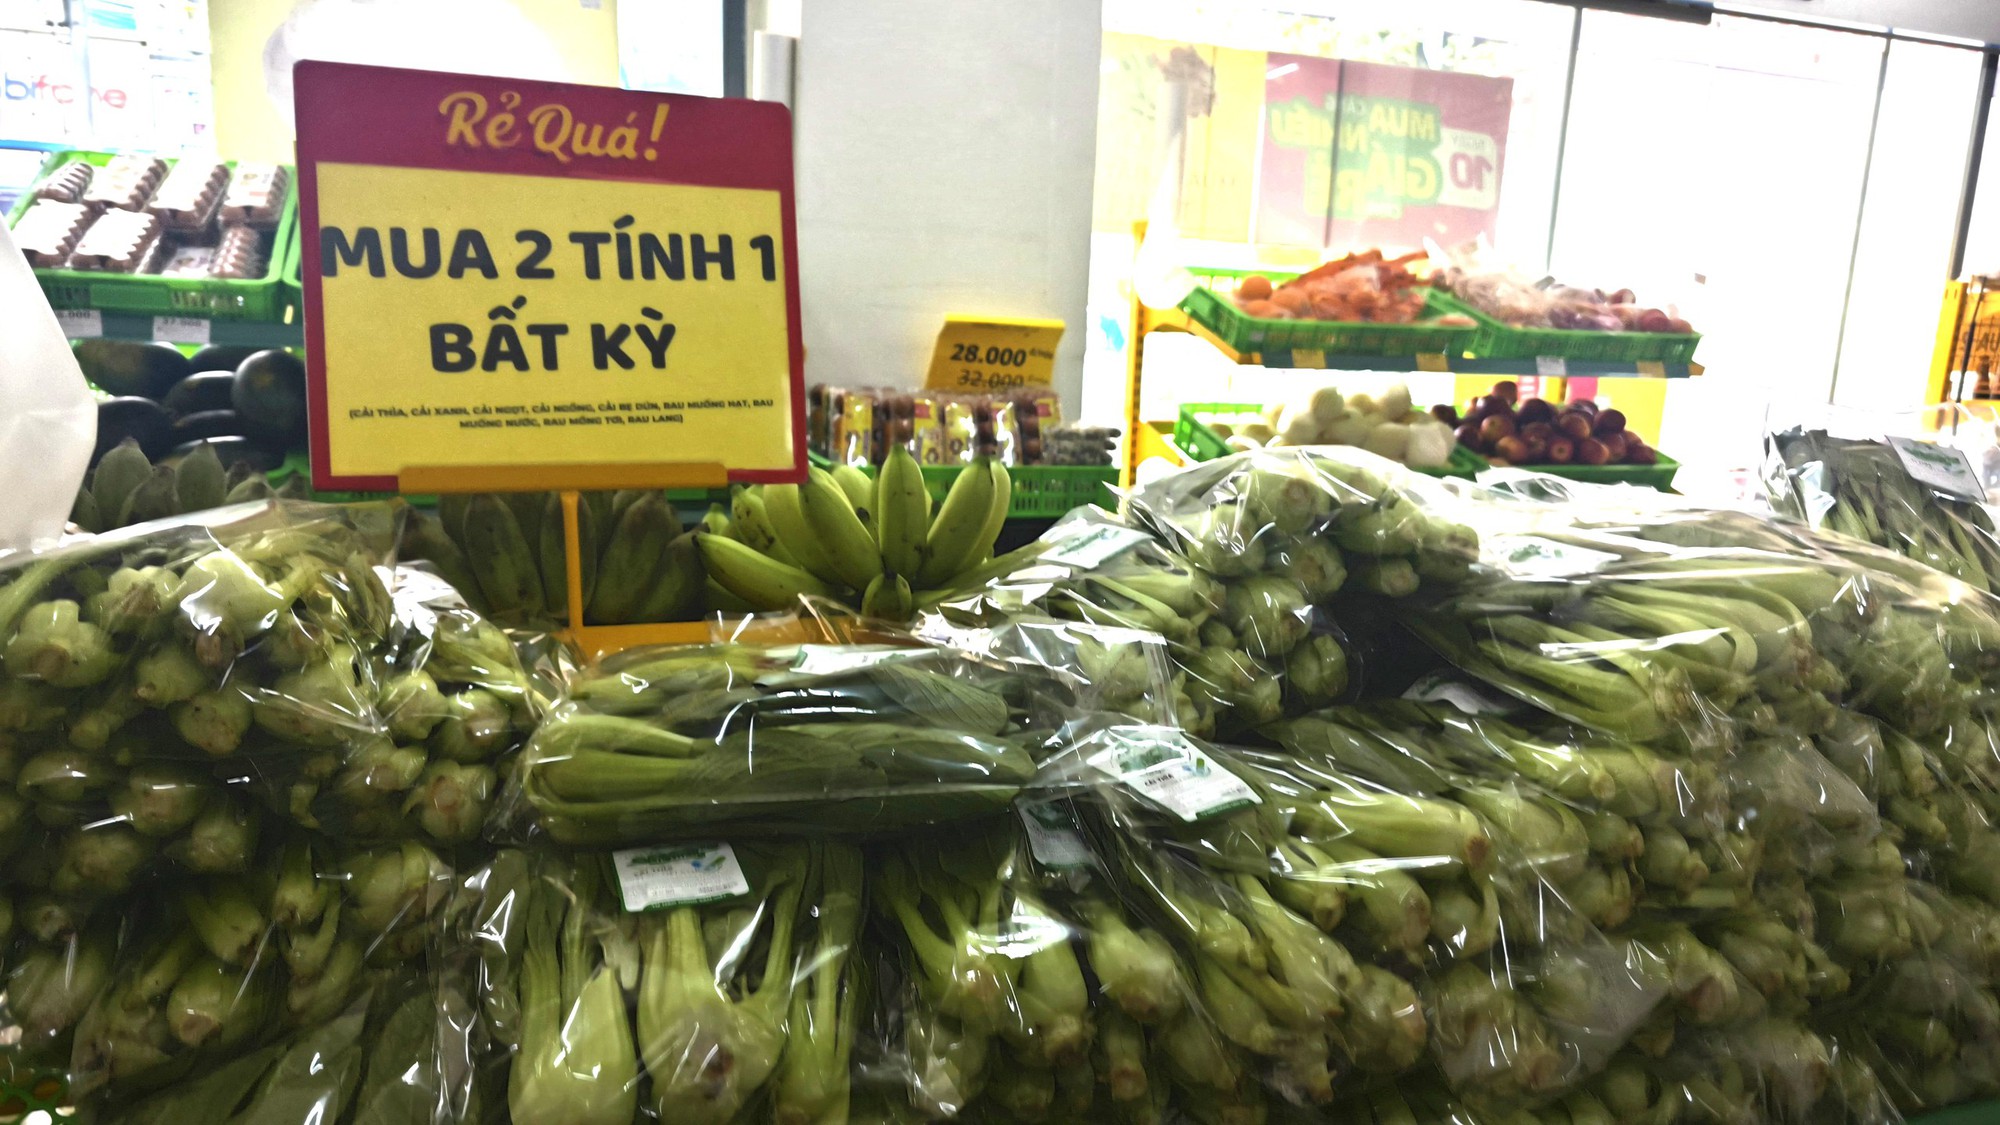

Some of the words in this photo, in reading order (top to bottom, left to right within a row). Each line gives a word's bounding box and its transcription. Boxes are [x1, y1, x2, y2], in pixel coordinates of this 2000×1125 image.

[438, 91, 522, 148] Rẻ
[527, 102, 670, 163] Quá!
[320, 226, 498, 280] MUA
[515, 229, 555, 280] 2
[568, 214, 735, 282] TÍNH
[749, 234, 777, 282] 1
[429, 294, 569, 372] BẤT
[590, 306, 676, 370] KỲ
[951, 343, 1027, 367] 28.000
[411, 404, 432, 417] CẢI
[472, 403, 493, 416] CẢI
